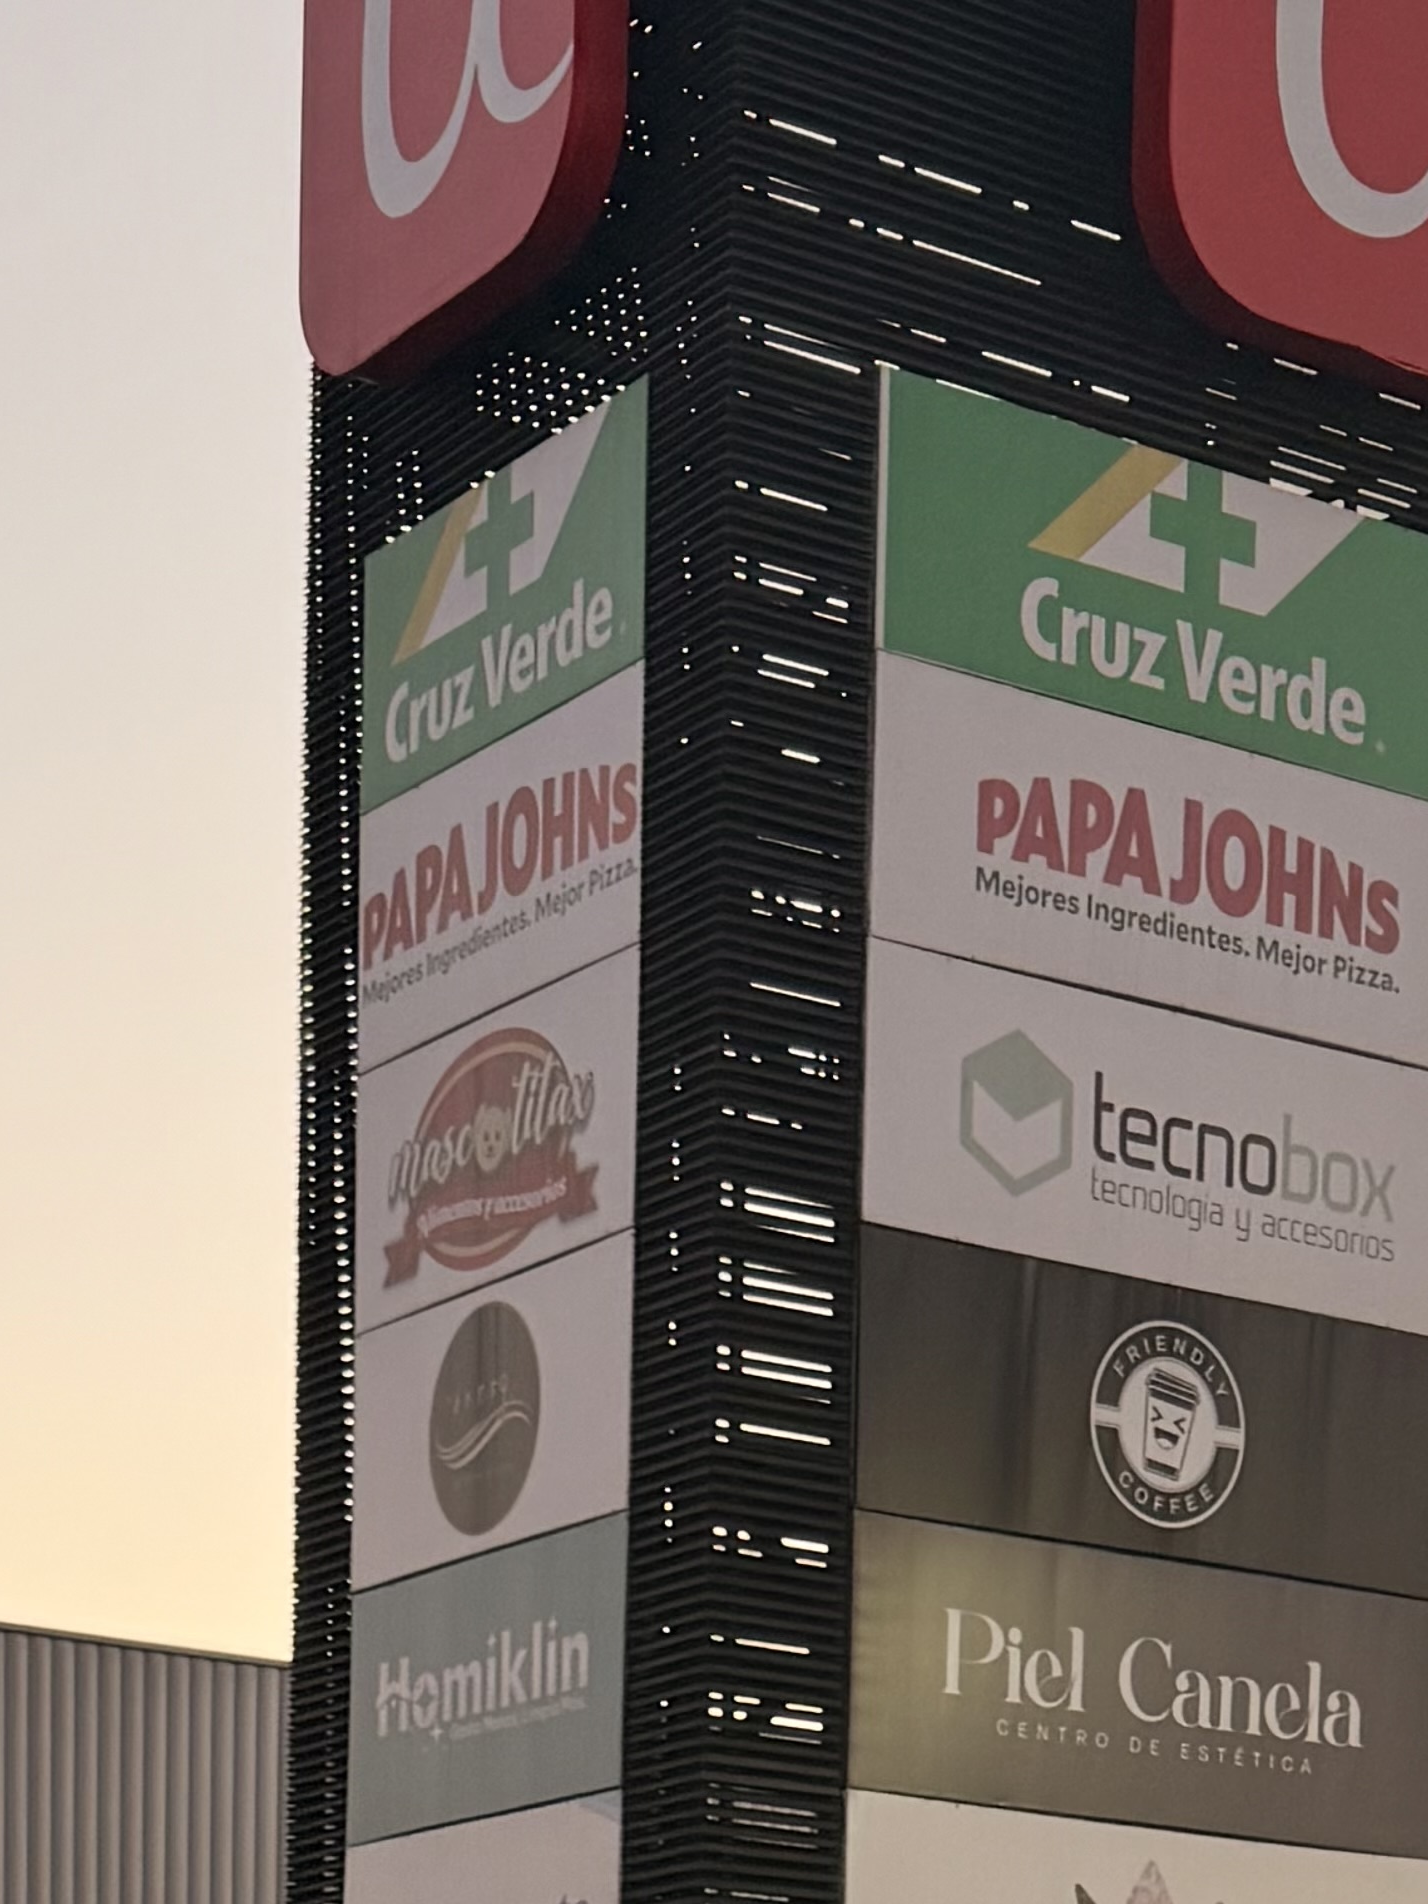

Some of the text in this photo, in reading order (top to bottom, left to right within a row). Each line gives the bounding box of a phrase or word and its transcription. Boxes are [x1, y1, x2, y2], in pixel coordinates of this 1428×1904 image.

[384, 578, 613, 763] Cruz Verde
[1020, 577, 1366, 745] Cruz Verde
[534, 880, 584, 922] Mejor
[975, 866, 1401, 994] Mejores Ingredientes. Mejor Pizza.
[1092, 1070, 1396, 1223] tecnobox
[1234, 1206, 1252, 1242] y
[1261, 1212, 1395, 1262] accesorios
[1112, 1334, 1229, 1397] FRIENDLY
[1118, 1471, 1215, 1514] COFFEE
[376, 1616, 589, 1738] Homiklin
[941, 1607, 1365, 1749] Piel Canela
[995, 1718, 1109, 1749] CENTRO
[1129, 1736, 1160, 1756] DE
